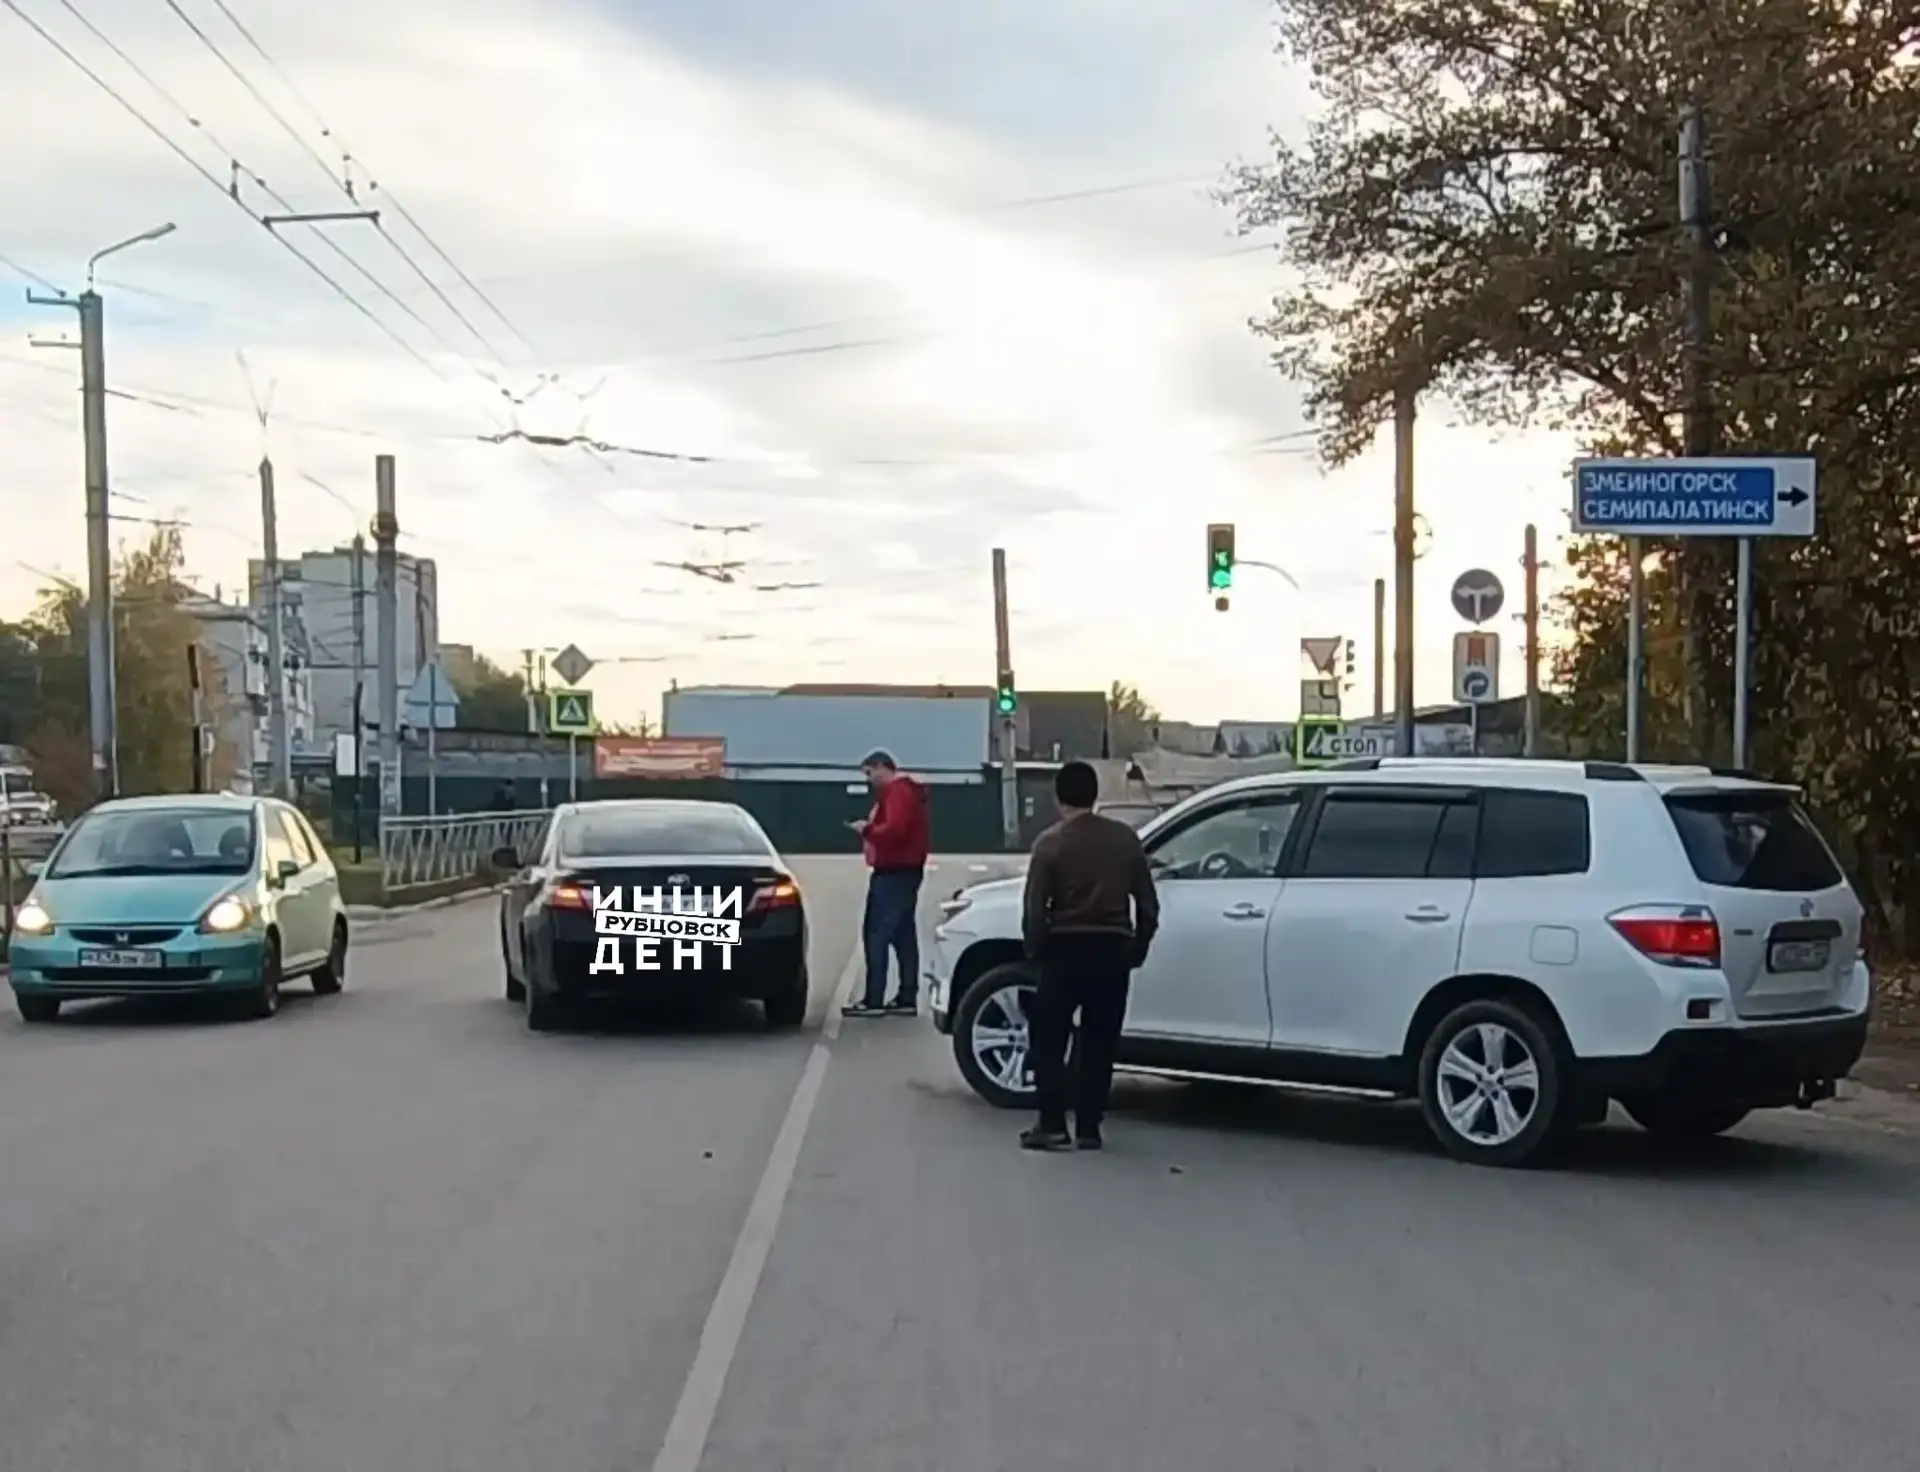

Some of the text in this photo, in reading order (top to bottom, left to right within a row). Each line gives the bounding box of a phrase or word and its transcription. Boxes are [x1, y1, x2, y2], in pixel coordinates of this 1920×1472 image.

[1584, 472, 1738, 493] ЗМЕИНОГОРСК
[1583, 499, 1770, 520] СЕМИПАЛАТИНСК
[1330, 737, 1378, 754] СТОП
